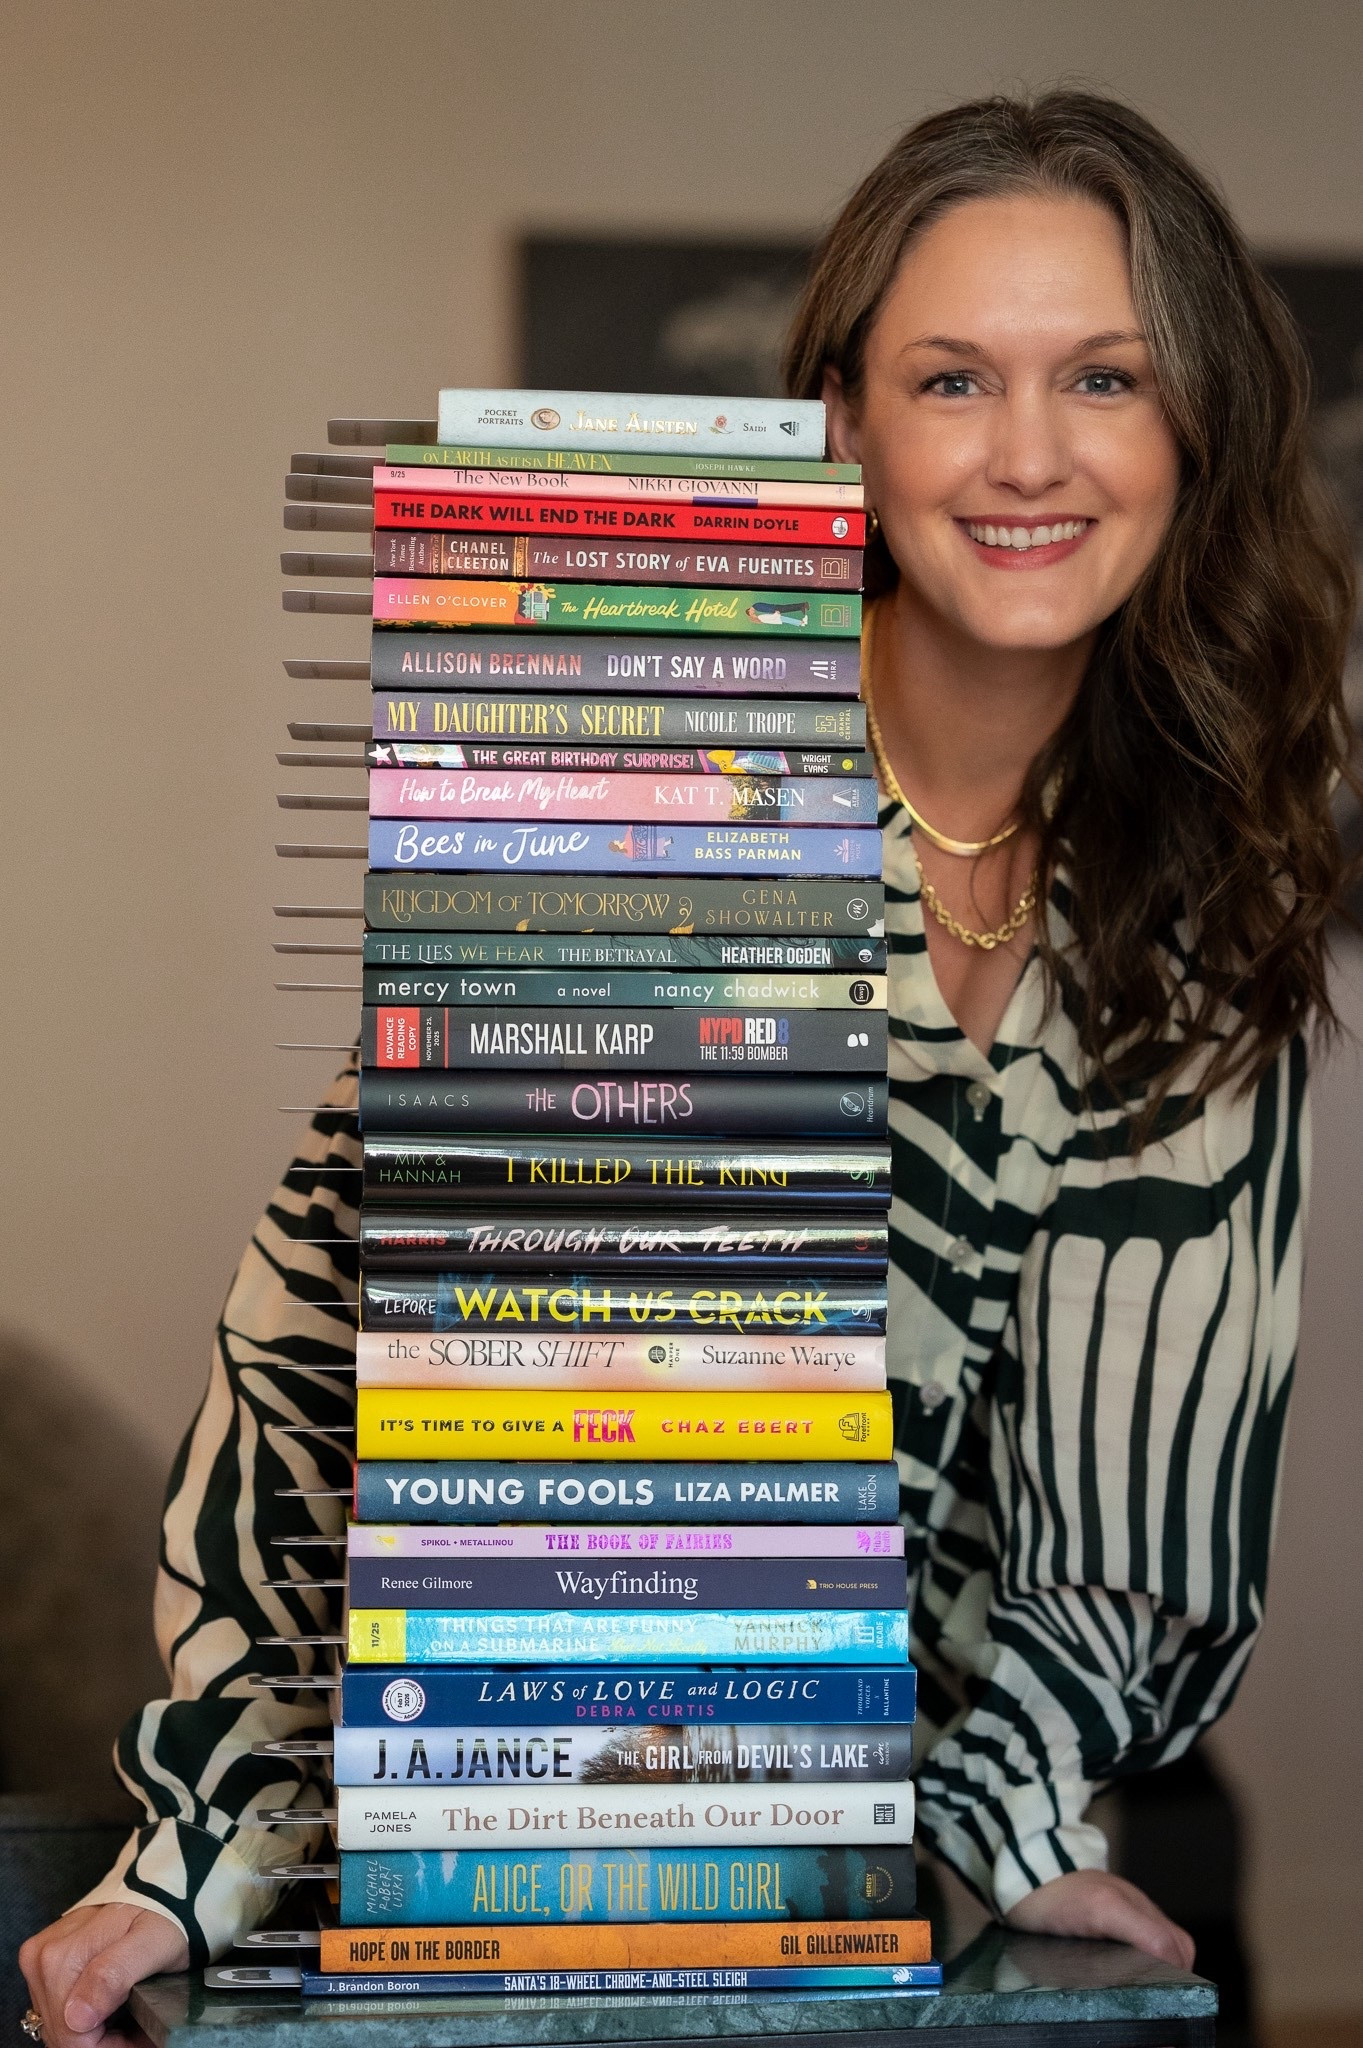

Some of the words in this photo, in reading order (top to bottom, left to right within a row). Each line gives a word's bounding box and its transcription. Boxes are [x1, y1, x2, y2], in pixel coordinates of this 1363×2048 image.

[478, 418, 524, 426] PORTRAITS
[695, 463, 725, 471] JOSEPH
[728, 464, 756, 472] HAWKE
[454, 469, 483, 485] The
[488, 471, 522, 486] New
[528, 473, 569, 488] Book
[628, 478, 672, 492] NIKKI
[678, 480, 758, 495] GIOVANNI
[391, 502, 425, 518] THE
[431, 504, 483, 520] DARK
[489, 506, 534, 522] WILL
[540, 509, 578, 523] END
[584, 510, 617, 525] THE
[623, 512, 676, 527] DARK
[694, 516, 749, 529] DARRIN
[754, 518, 799, 531] DOYLE
[450, 541, 506, 555] CHANEL
[448, 557, 509, 570] CLEETON
[533, 552, 559, 564] The
[566, 551, 608, 568] LOST
[616, 552, 671, 570] STORY
[676, 556, 690, 571] of
[696, 556, 729, 573] EVA
[738, 558, 814, 576] FUENTES
[388, 594, 430, 605] ELLEN
[436, 595, 506, 608] O'CLOVER
[560, 602, 579, 613] The
[583, 597, 680, 620] Heartbreak
[685, 598, 739, 623] Hotel
[402, 652, 482, 674] ALLISON
[489, 654, 582, 676] BRENNAN
[607, 655, 662, 678] DON'T
[671, 656, 705, 678] SAY
[712, 657, 724, 678] A
[732, 657, 786, 679] WORD
[387, 702, 420, 732] MY
[434, 702, 568, 735] DAUGHTER'S
[581, 704, 664, 736] SECRET
[685, 711, 738, 733] NICOLE
[746, 712, 796, 734] TROPE
[472, 750, 498, 764] THE
[503, 751, 546, 765] GREAT
[551, 752, 618, 767] BIRTHDAY
[623, 753, 694, 769] SURPRISE!
[801, 754, 831, 764] WRIGHT
[803, 765, 828, 773] EVANS
[654, 786, 698, 805] KAT
[705, 787, 723, 805] T.
[731, 788, 805, 807] MASEN
[707, 832, 789, 844] ELIZABETH
[695, 848, 732, 859] BASS
[738, 849, 801, 860] PARMAN
[742, 890, 797, 905] GENA
[705, 910, 834, 927] SHOWALTER
[721, 947, 782, 964] HEATHER
[786, 948, 831, 965] OGDEN
[378, 981, 449, 1002] mercy
[461, 978, 516, 996] town
[557, 987, 565, 997] a
[573, 983, 610, 997] novel
[654, 984, 714, 1002] nancy
[724, 978, 819, 999] chadwick
[386, 1017, 394, 1060] ADVANCE
[398, 1018, 406, 1059] READING
[408, 1026, 417, 1051] COPY
[470, 1023, 587, 1055] MARSHALL
[596, 1024, 653, 1055] KARP
[700, 1046, 717, 1060] THE
[720, 1046, 744, 1060] 11:59
[748, 1046, 788, 1060] BOMBER
[388, 1095, 469, 1107] ISAACS
[526, 1088, 556, 1112] THE
[572, 1081, 693, 1123] OTHERS
[385, 1298, 436, 1315] LEPORE
[388, 1339, 420, 1359] the
[429, 1339, 525, 1367] SOBER
[533, 1340, 624, 1368] SHIFT
[702, 1345, 786, 1365] Suzanne
[791, 1346, 856, 1371] Warye
[380, 1419, 414, 1432] IT'S
[421, 1419, 464, 1432] TIME
[471, 1420, 495, 1432] TO
[502, 1420, 545, 1432] GIVE
[552, 1421, 564, 1432] A
[573, 1410, 635, 1443] FECK
[661, 1420, 725, 1433] CHAZ
[738, 1420, 813, 1434] EBERT
[385, 1478, 525, 1505] YOUNG
[539, 1478, 654, 1506] FOOLS
[675, 1482, 732, 1502] LIZA
[740, 1482, 840, 1502] PALMER
[858, 1486, 867, 1511] LAKE
[868, 1474, 877, 1510] UNION
[381, 1577, 418, 1589] Renee
[423, 1577, 473, 1589] Gilmore
[555, 1570, 698, 1600] Wayfinding
[372, 1622, 380, 1648] 11/25
[478, 1681, 566, 1702] LAWS
[572, 1686, 587, 1700] of
[593, 1681, 675, 1700] LOVE
[688, 1683, 718, 1696] and
[724, 1680, 819, 1700] LOGIC
[576, 1705, 635, 1717] DEBRA
[648, 1704, 715, 1717] CURTIS
[617, 1750, 638, 1766] THE
[645, 1746, 694, 1770] GIRL
[699, 1750, 732, 1764] FROM
[737, 1744, 812, 1769] DEVIL'S
[820, 1744, 868, 1768] LAKE
[364, 1811, 417, 1820] PAMELA
[442, 1807, 497, 1831] The
[507, 1807, 567, 1830] Dirt
[577, 1804, 695, 1829] Beneath
[705, 1805, 762, 1827] Our
[771, 1803, 844, 1826] Door
[876, 1806, 884, 1822] MATT
[885, 1806, 893, 1822] HOLT
[370, 1824, 412, 1832] JONES
[366, 1860, 378, 1913] MICHAEL
[379, 1865, 392, 1912] ROBERT
[392, 1874, 403, 1908] LISKA
[473, 1864, 550, 1916] ALICE,
[560, 1864, 593, 1912] OR
[603, 1863, 648, 1911] THE
[658, 1863, 718, 1910] WILD
[730, 1862, 785, 1910] GIRL
[350, 1942, 385, 1961] HOPE
[391, 1942, 409, 1960] ON
[415, 1941, 440, 1960] THE
[445, 1940, 500, 1960] BORDER
[781, 1935, 802, 1955] GIL
[807, 1934, 898, 1955] GILLENWATER
[328, 1982, 338, 1992] J.
[339, 1981, 383, 1992] Brandon
[388, 1981, 420, 1990] Boron
